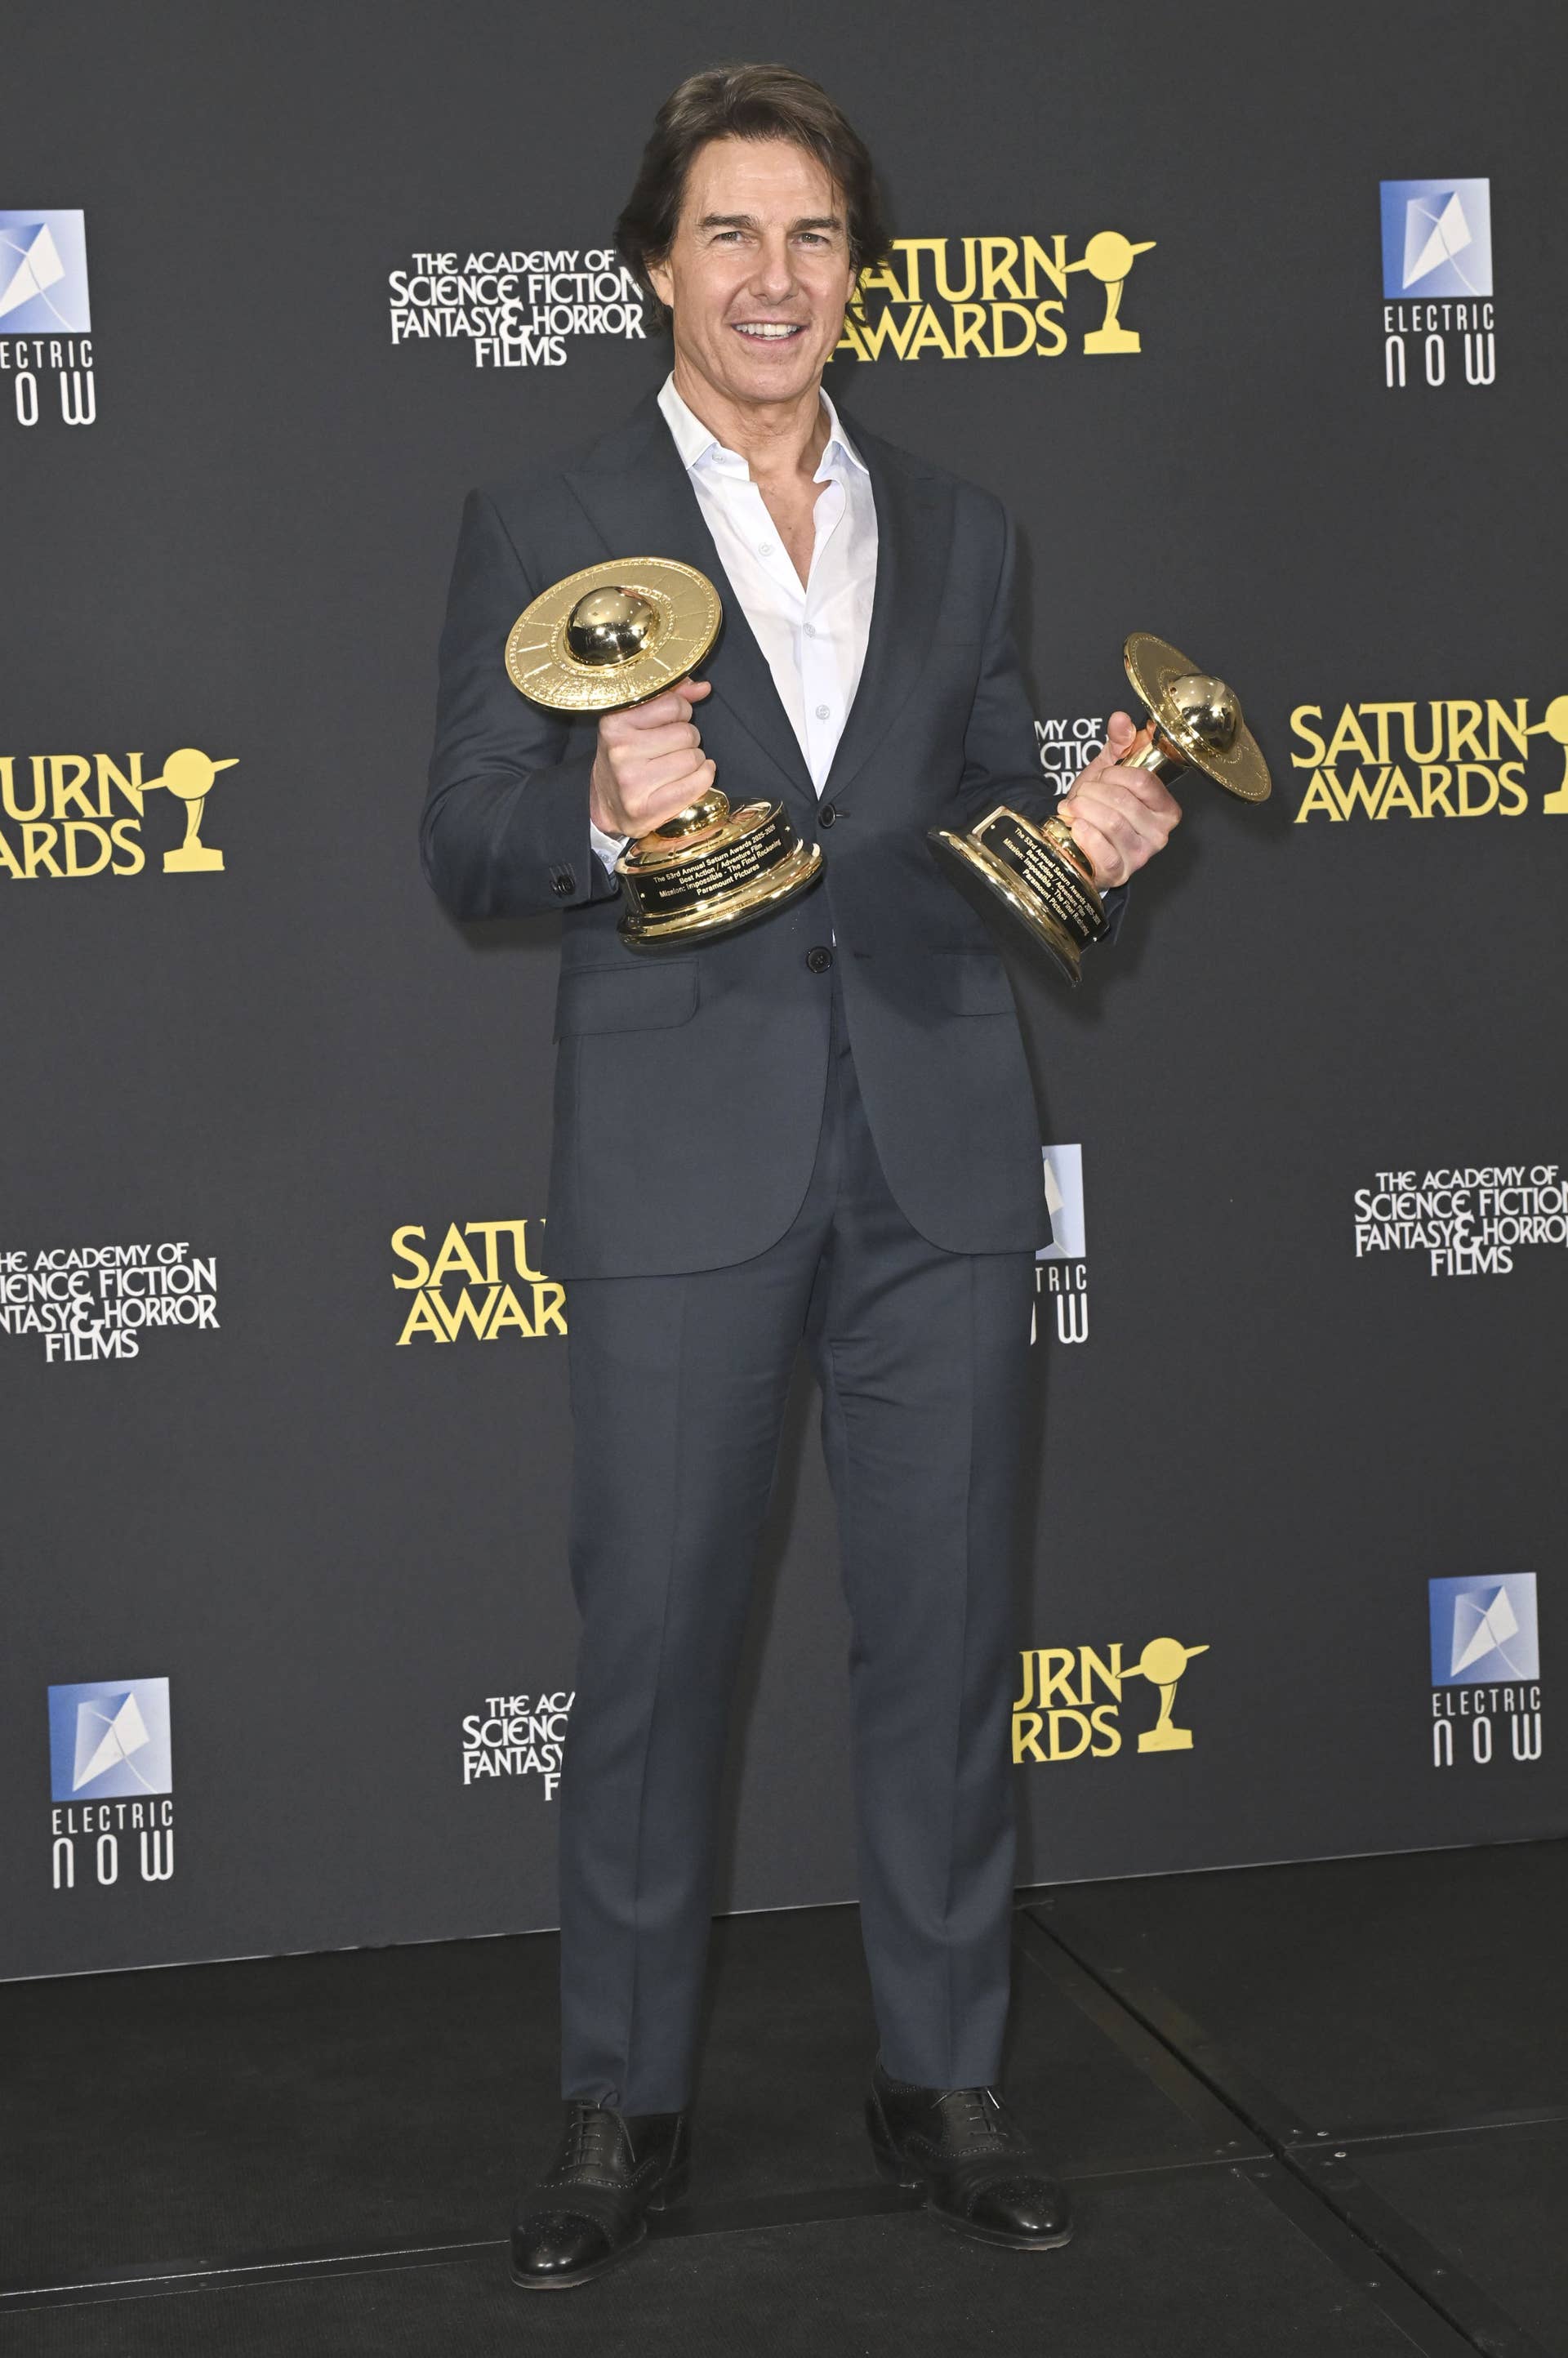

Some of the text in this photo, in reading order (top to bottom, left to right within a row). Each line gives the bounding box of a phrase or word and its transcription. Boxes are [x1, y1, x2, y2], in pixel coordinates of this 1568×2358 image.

[412, 249, 615, 274] THE ACADEMY OF
[389, 270, 521, 307] SCIENCE
[390, 306, 502, 345] FANTASY
[532, 303, 647, 339] HORROR
[1383, 302, 1494, 332] ELECTRIC
[0, 340, 93, 369] ECTRIC
[474, 336, 567, 368] FILMS
[1072, 718, 1102, 739] OF
[1290, 698, 1529, 769] SATURN
[1293, 761, 1529, 823] AWARDS
[666, 871, 681, 880] 53rd
[682, 862, 706, 875] Annual
[706, 853, 728, 866] Saturn
[729, 840, 751, 856] Awards
[679, 875, 694, 884] Best
[695, 867, 715, 879] Action
[720, 850, 751, 868] Adventure
[751, 843, 763, 853] Film
[686, 872, 723, 890] Impossible
[727, 863, 741, 873] The
[741, 854, 757, 867] Final
[1003, 837, 1025, 860] Mission:
[1023, 857, 1052, 888] Impossible
[1054, 889, 1064, 902] The
[1062, 899, 1076, 915] Final
[1014, 827, 1025, 839] The
[1023, 836, 1038, 850] 53rd
[1035, 849, 1056, 869] Annual
[1053, 866, 1071, 886] Saturn
[1069, 885, 1086, 905] Awards
[697, 864, 760, 896] Paramount Pictures
[1022, 868, 1067, 920] Paramount Pictures
[1026, 849, 1040, 863] Best
[1036, 861, 1054, 880] Action
[1055, 881, 1078, 907] Adventure
[1375, 1166, 1559, 1192] THE ACADEMY OF
[1353, 1189, 1472, 1223] SCIENCE
[1355, 1219, 1455, 1257] FANTASY
[1482, 1215, 1568, 1248] HORRO
[33, 1244, 153, 1271] ACADEMY
[157, 1242, 189, 1265] OF
[1430, 1246, 1513, 1277] FILMS
[99, 1257, 217, 1298] FICTION
[103, 1294, 221, 1329] HORROR
[395, 1282, 568, 1346] AWAR
[46, 1329, 140, 1363] FILMS
[485, 1695, 530, 1718] THE
[1432, 1686, 1541, 1718] ELECTRIC
[51, 1800, 173, 1835] ELECTRIC
